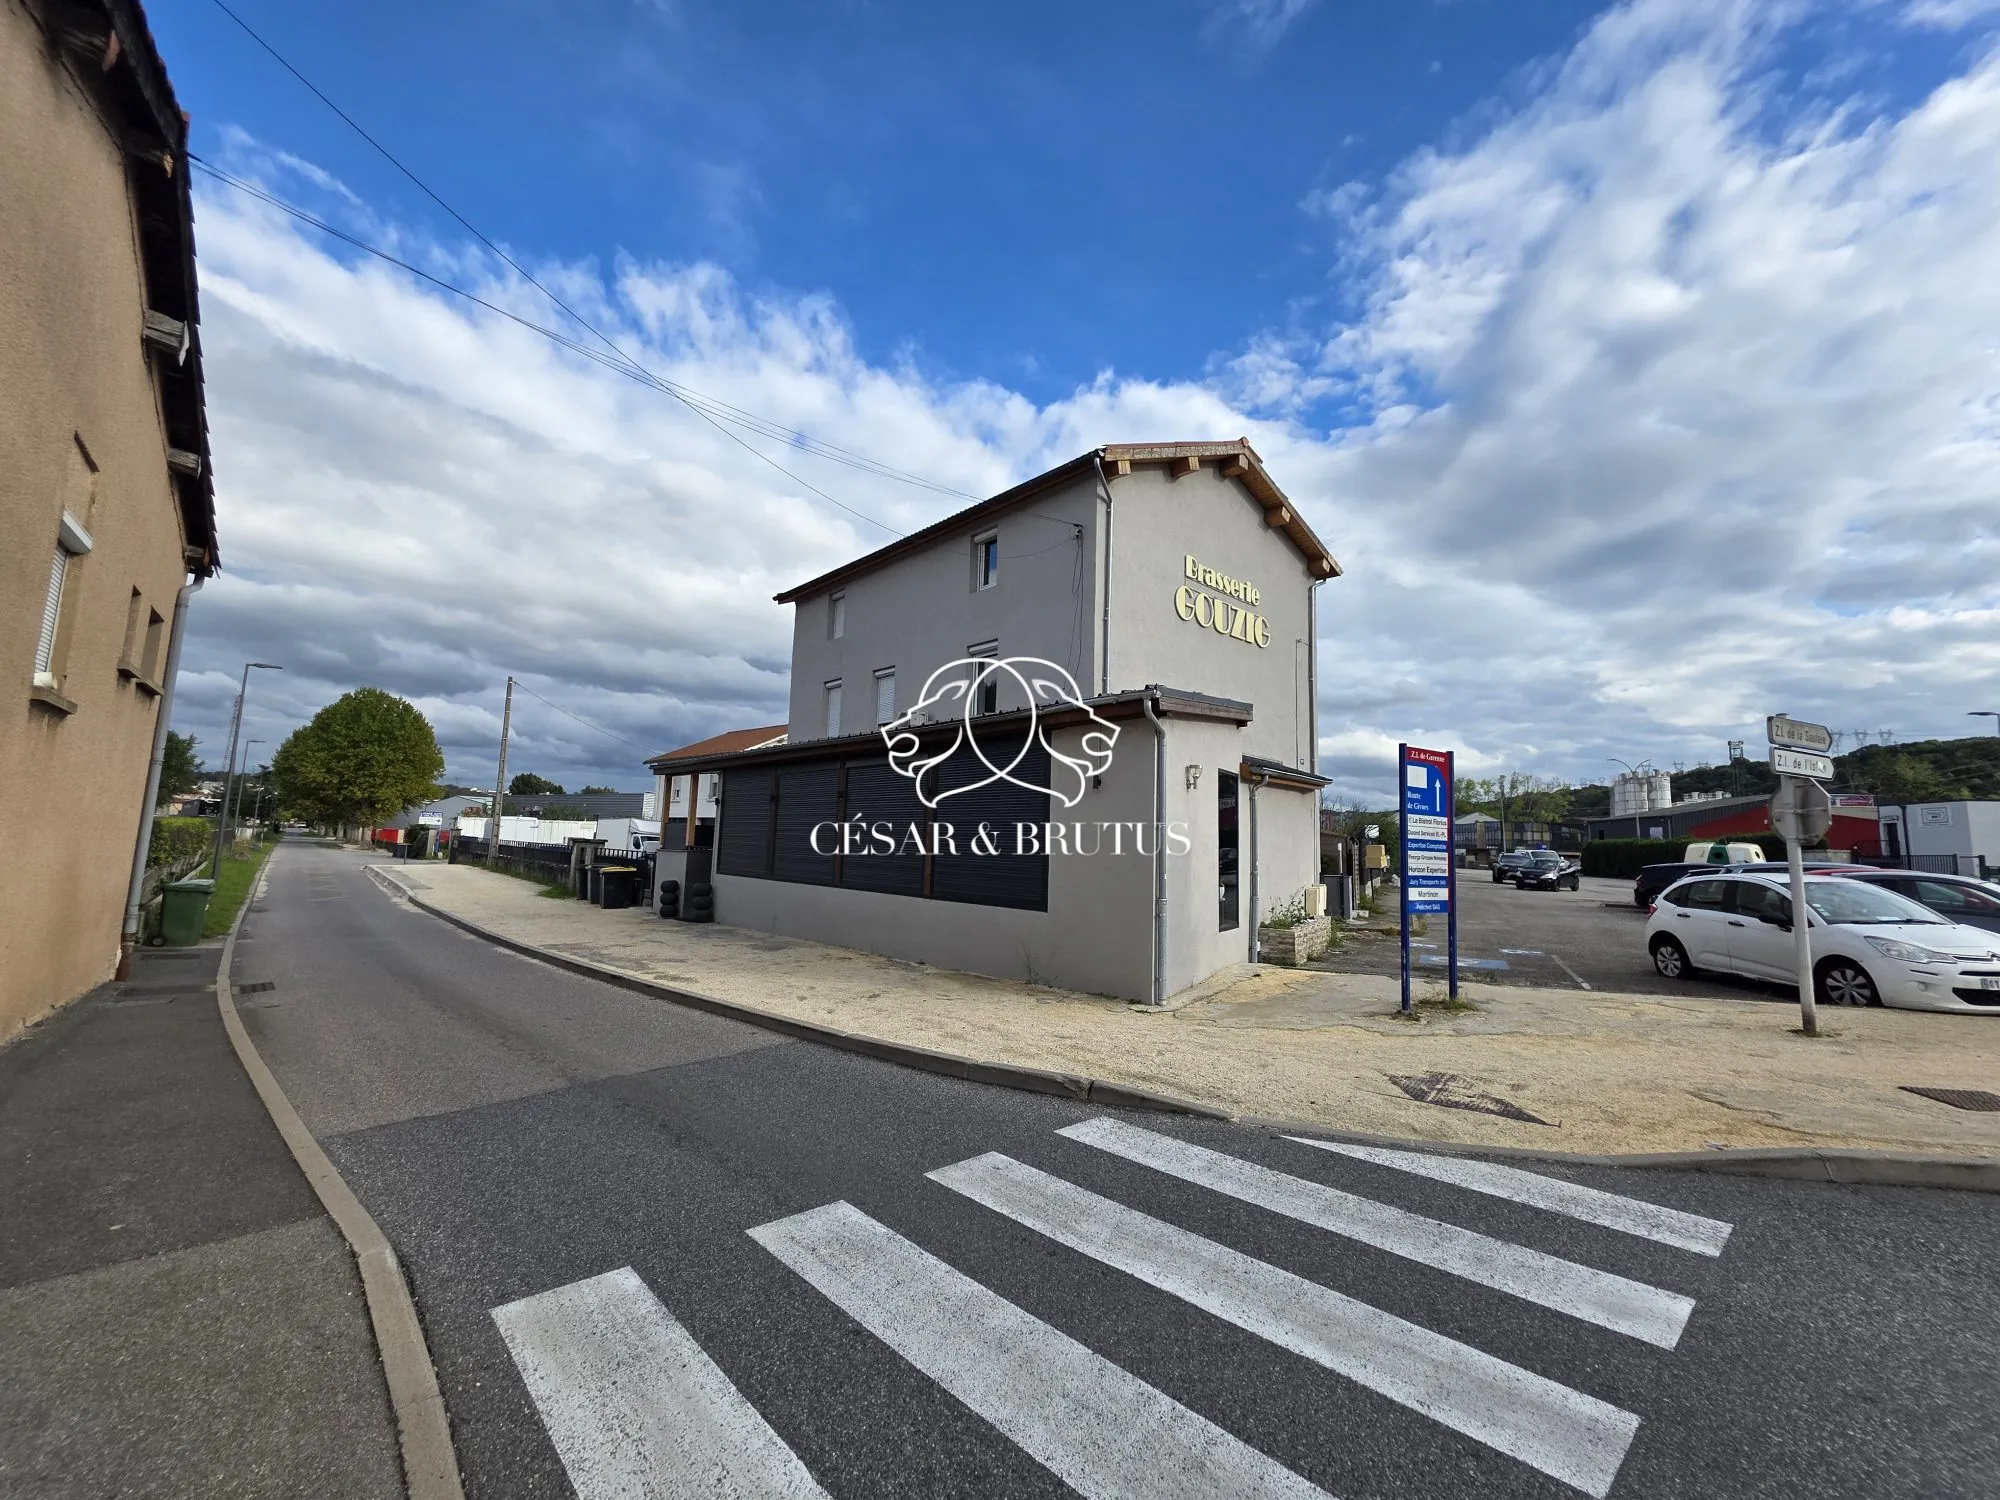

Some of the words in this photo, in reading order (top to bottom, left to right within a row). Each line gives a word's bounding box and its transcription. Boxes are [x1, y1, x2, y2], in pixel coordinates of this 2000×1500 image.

[1184, 554, 1260, 606] Brasserie
[1174, 585, 1270, 648] GOUZIG
[1787, 727, 1795, 739] de
[1793, 757, 1801, 769] de
[1805, 758, 1827, 772] l'Isln
[1407, 791, 1421, 799] Route
[1419, 817, 1432, 825] Bistrot
[1408, 865, 1426, 873] Horizon
